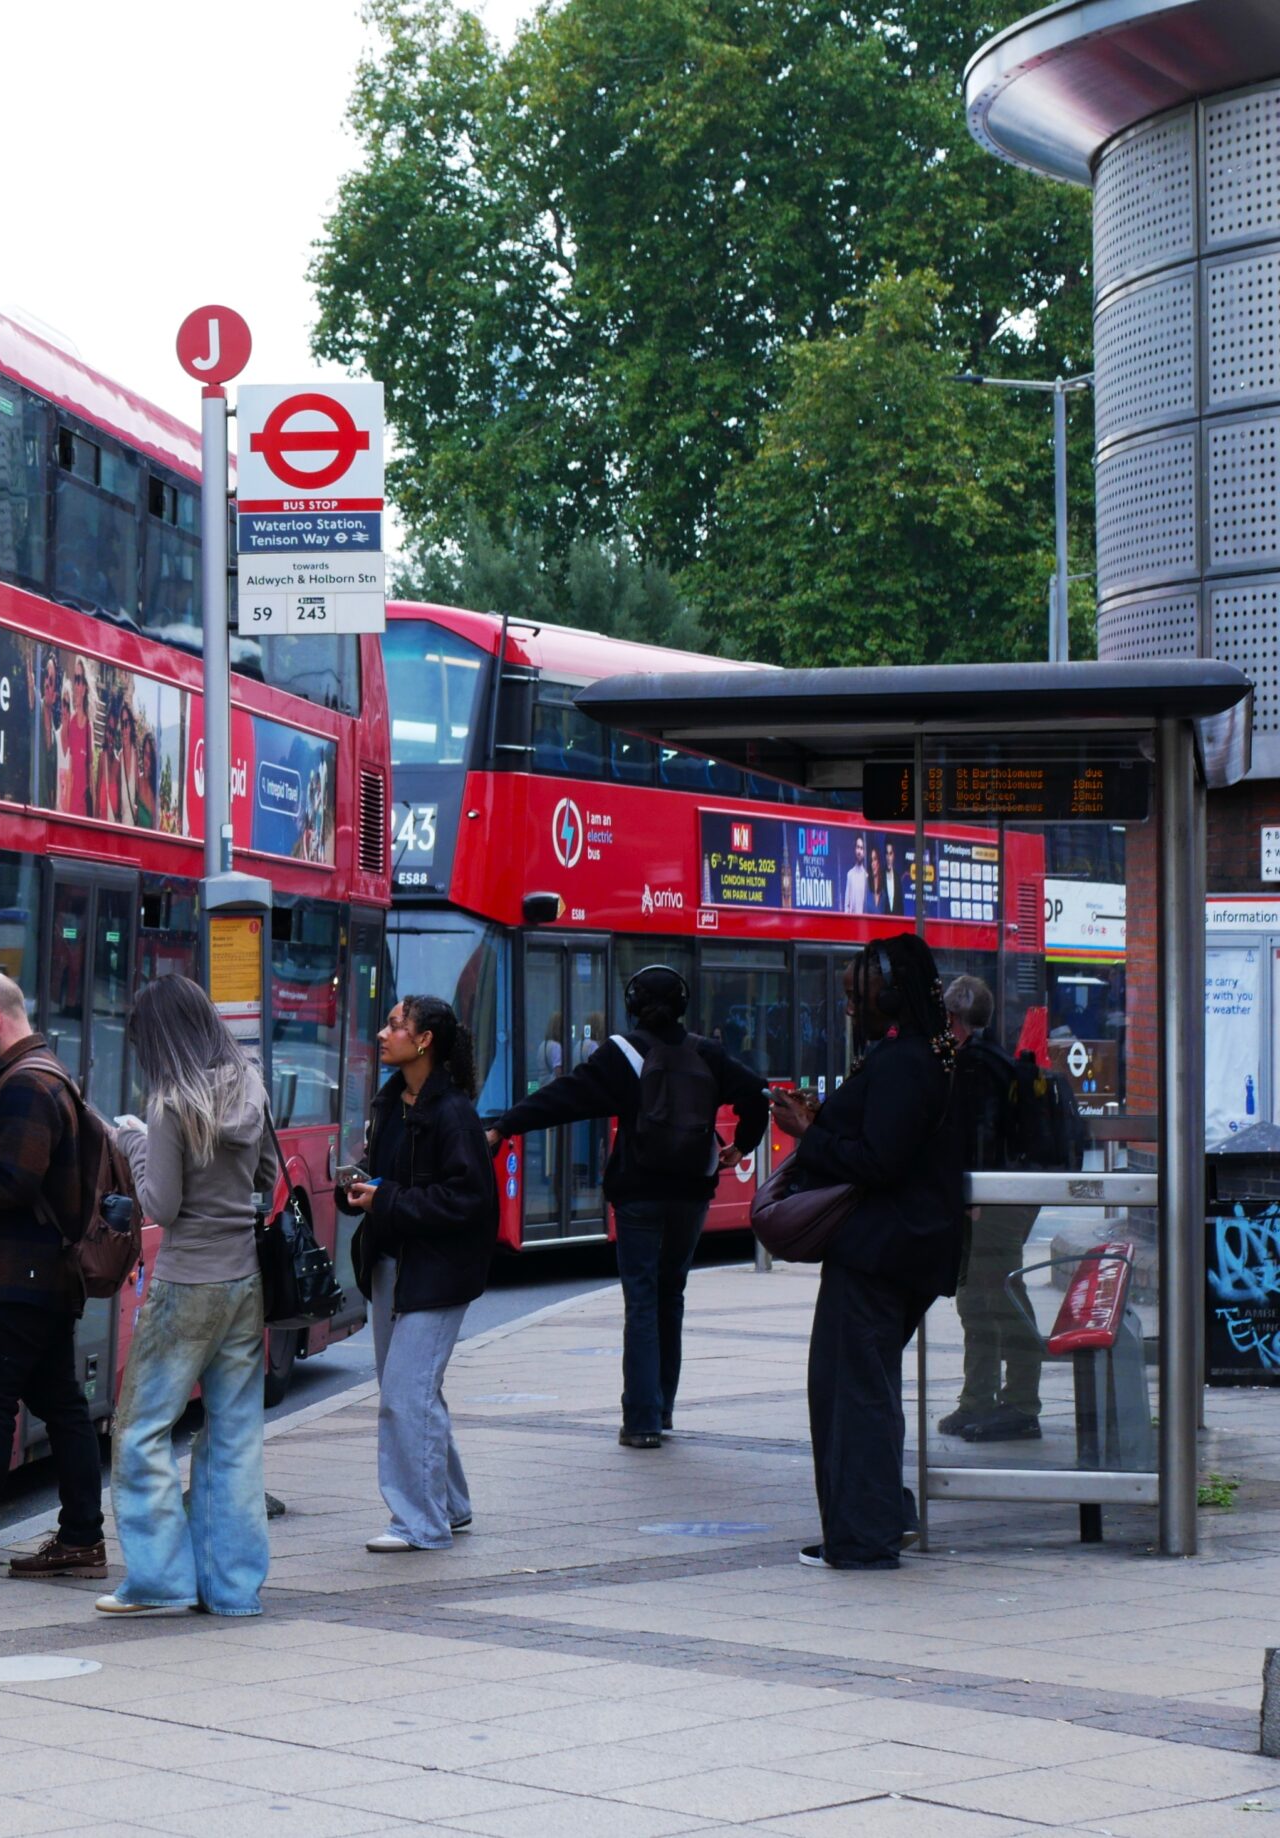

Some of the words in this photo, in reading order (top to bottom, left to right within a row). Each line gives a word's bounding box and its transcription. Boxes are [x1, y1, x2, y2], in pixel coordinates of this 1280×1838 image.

[191, 318, 220, 371] J
[283, 502, 304, 510] BUS
[309, 500, 338, 510] STOP
[253, 520, 312, 532] Waterloo
[250, 534, 298, 546] Tenison
[302, 534, 330, 546] Way
[292, 562, 330, 571] towards
[246, 576, 294, 587] Aldwych
[298, 575, 306, 584] &
[310, 574, 354, 584] Holborn
[358, 574, 377, 583] Stn
[253, 607, 272, 621] 59
[296, 606, 326, 620] 243
[928, 769, 943, 778] 59
[956, 768, 968, 778] St
[972, 768, 1044, 778] Bartholomews
[1084, 769, 1103, 778] due
[266, 780, 284, 800] Intrepid
[285, 782, 298, 802] Travel
[956, 780, 968, 790] St
[972, 780, 1044, 790] Bartholomews
[956, 792, 982, 801] Wood
[986, 792, 1016, 801] Green
[590, 814, 602, 826] am
[602, 814, 612, 826] an
[587, 829, 613, 844] electric
[588, 847, 600, 860] bus
[758, 859, 776, 873] 2025
[398, 872, 428, 886] ES88
[721, 874, 745, 886] LONDON
[746, 876, 766, 887] HILTON
[654, 887, 683, 910] arriva
[722, 890, 731, 900] ON
[732, 890, 748, 900] PARK
[748, 892, 763, 902] LANE
[572, 908, 586, 920] ES88
[1213, 910, 1278, 923] information
[1215, 978, 1238, 989] carry
[1213, 992, 1234, 1000] with
[1237, 992, 1252, 1002] you
[1213, 1005, 1250, 1014] weather
